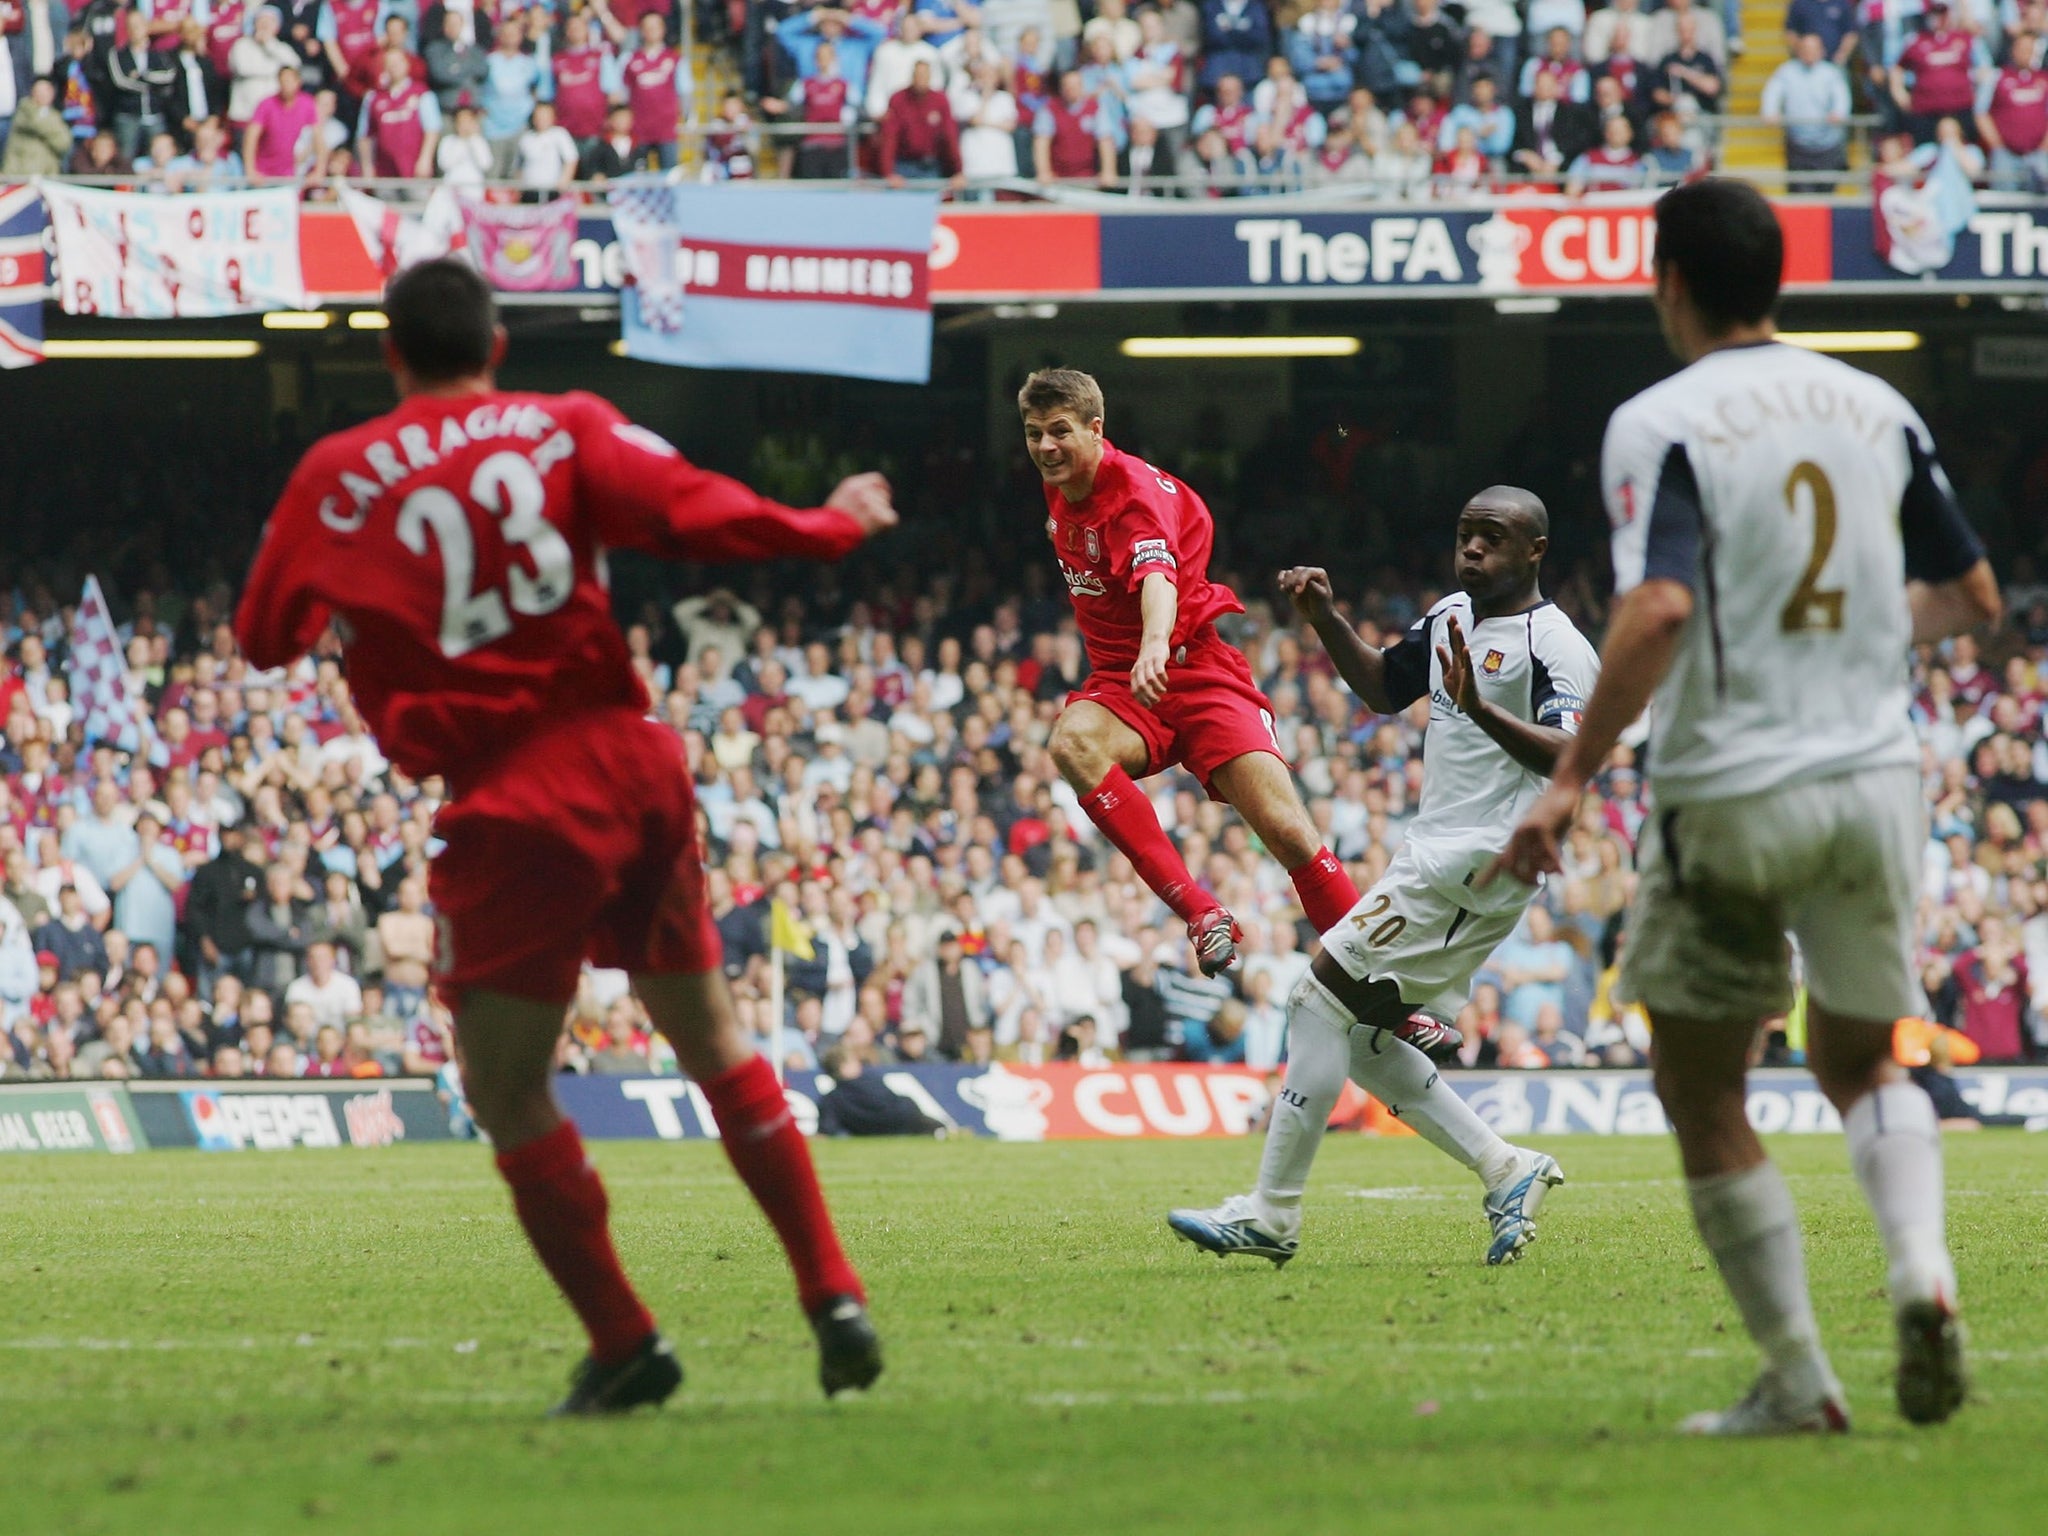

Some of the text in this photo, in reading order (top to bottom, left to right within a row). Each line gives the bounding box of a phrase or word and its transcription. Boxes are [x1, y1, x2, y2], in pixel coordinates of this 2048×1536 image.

[1968, 212, 2048, 278] Th
[746, 254, 913, 299] HAMMERS
[395, 450, 575, 659] 23
[1780, 460, 1847, 634] 2
[1350, 894, 1407, 949] 20
[31, 1109, 95, 1149] BEER
[214, 1094, 343, 1151] PEPSI
